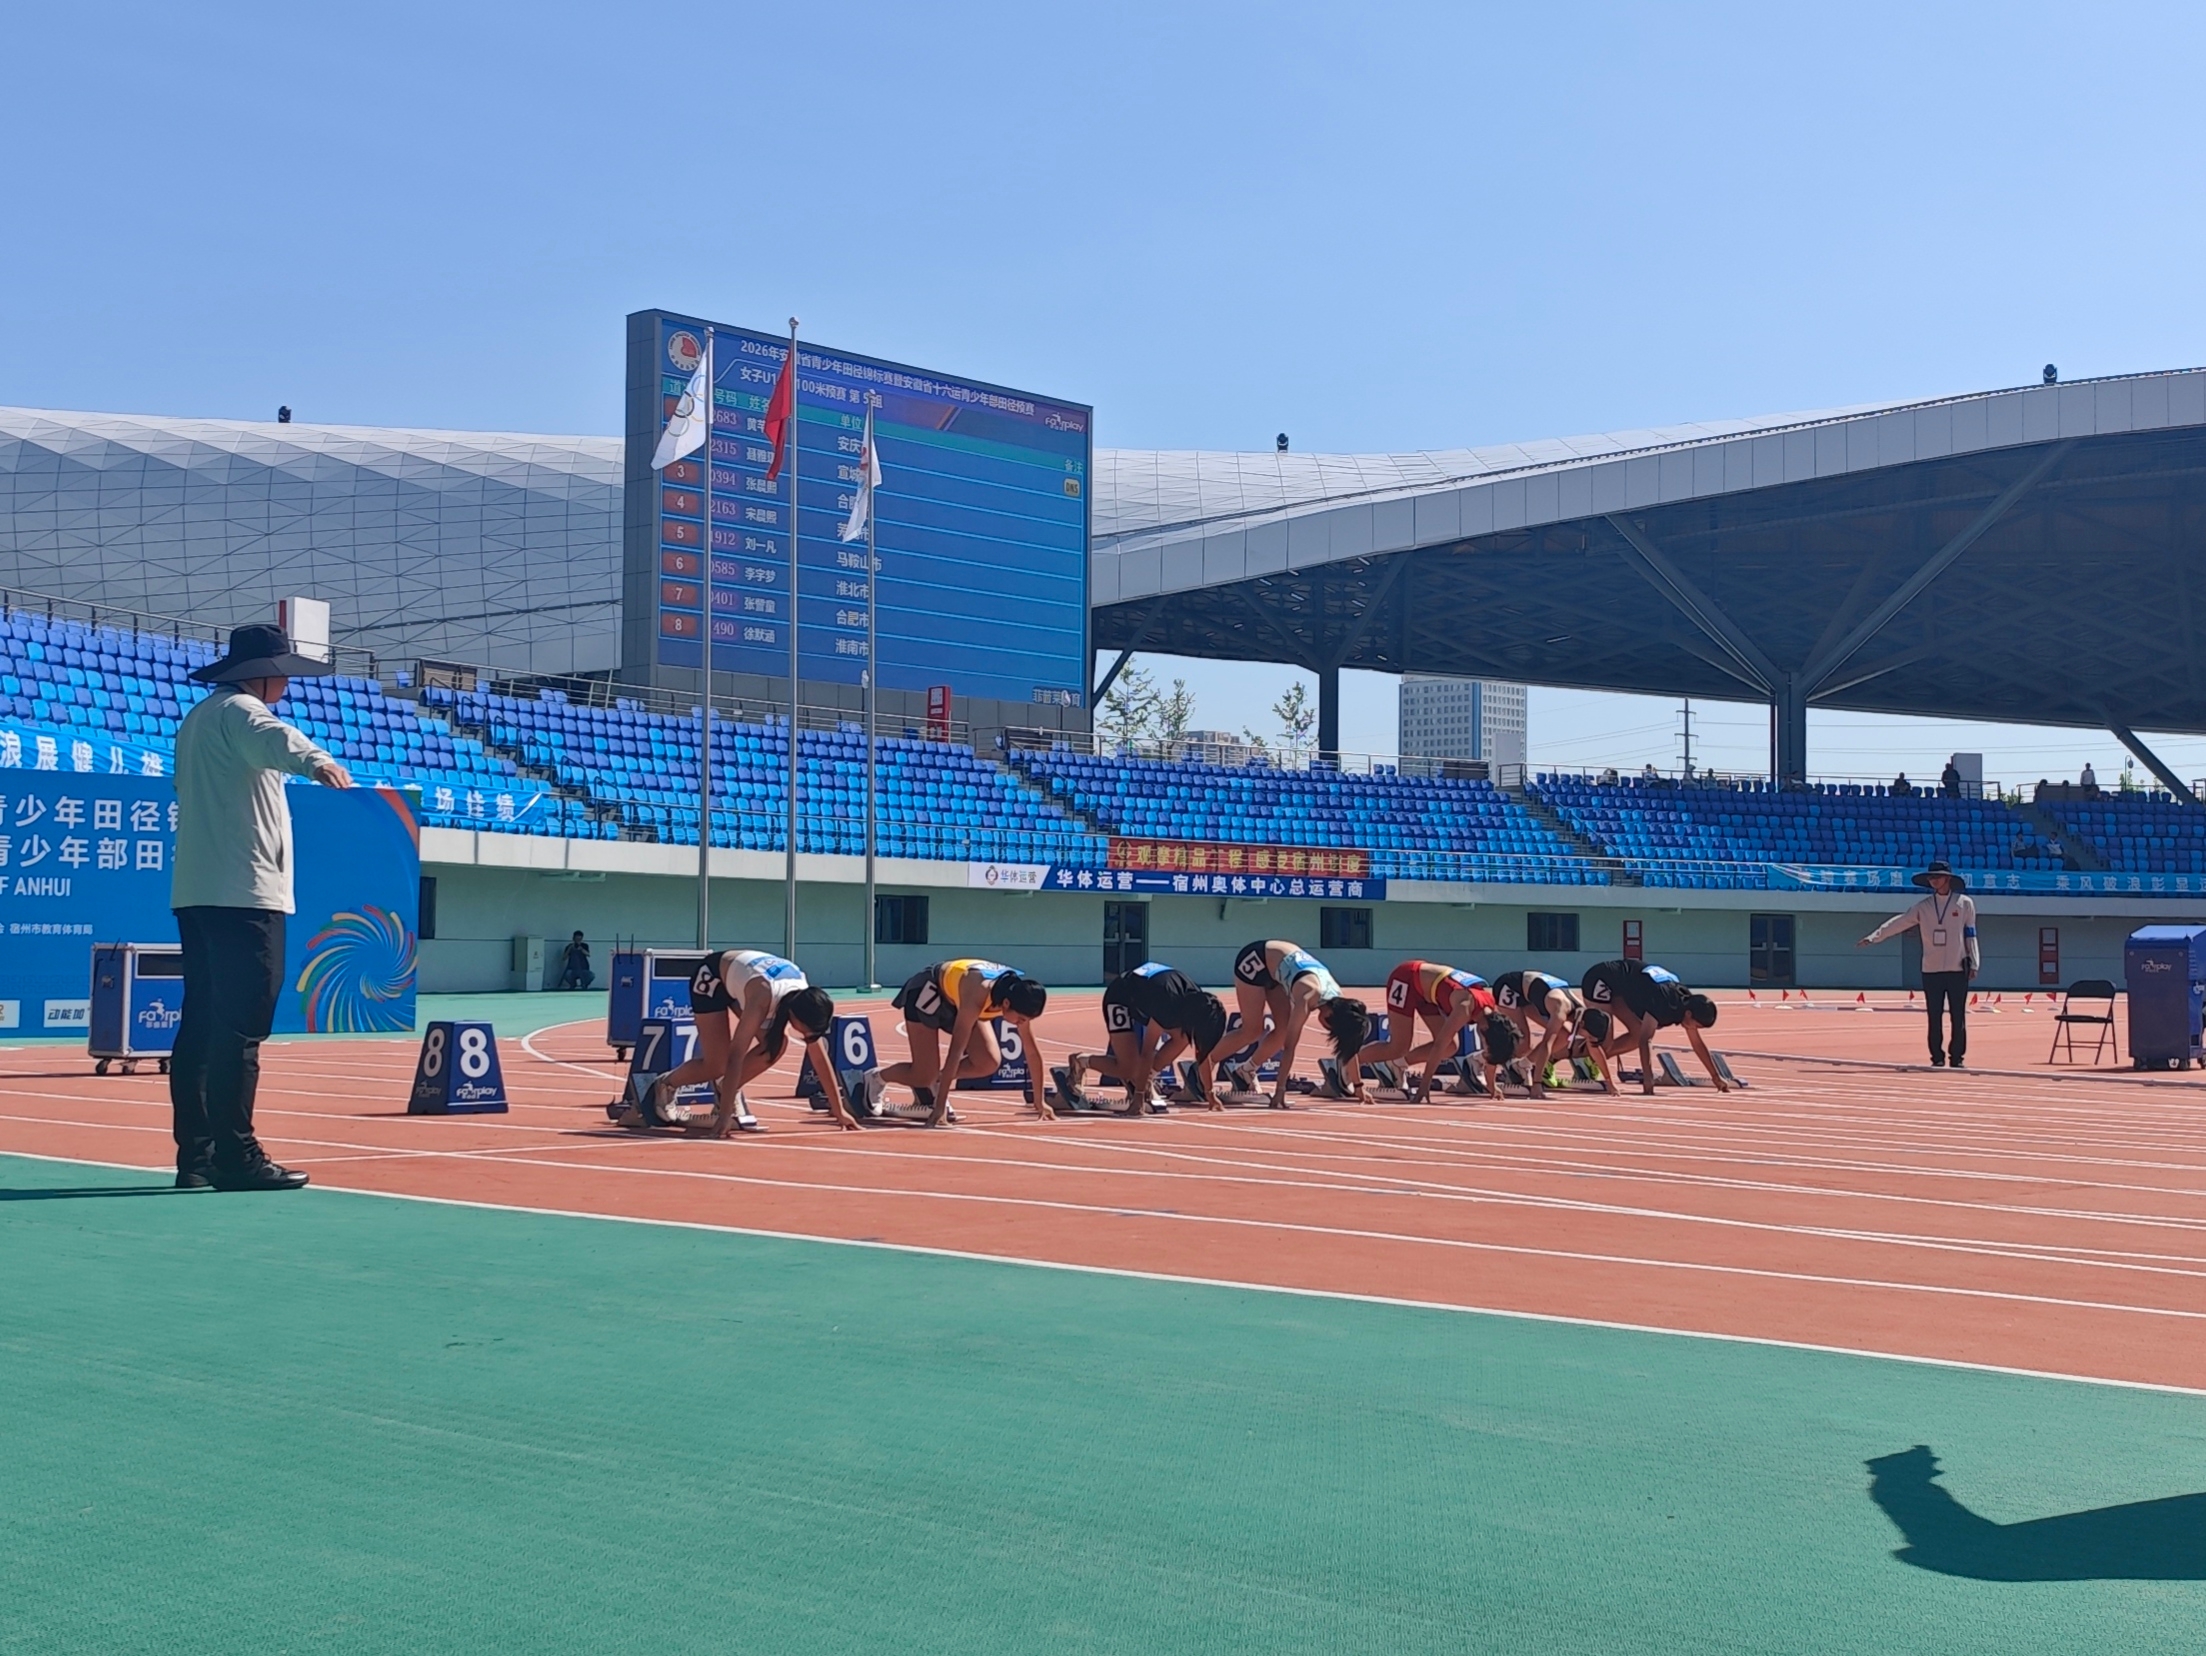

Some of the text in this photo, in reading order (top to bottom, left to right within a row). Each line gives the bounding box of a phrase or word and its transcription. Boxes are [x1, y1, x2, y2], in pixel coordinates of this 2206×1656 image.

[740, 366, 777, 386] 女子U1
[740, 339, 1035, 416] 2026年安省青少年田径锦标赛暨安徽省十六运青少年部田径预赛
[714, 388, 737, 406] 号码
[840, 414, 862, 430] 单位
[1064, 459, 1083, 474] 备注
[677, 465, 686, 477] 3
[677, 495, 685, 509] 4
[676, 526, 685, 539] 5
[745, 536, 778, 554] 刘一凡
[676, 556, 684, 570] 6
[836, 580, 869, 599] 淮北市
[675, 587, 683, 600] 7
[835, 609, 869, 628] 合肥市
[675, 618, 683, 631] 8
[835, 638, 869, 657] 淮南市
[1032, 688, 1082, 708] 菲普莱育
[0, 794, 179, 833] 少年田径
[0, 834, 175, 871] 少年部田
[14, 877, 71, 896] ANHUI
[1001, 869, 1037, 884] 华体运营
[1243, 957, 1261, 976] 5
[699, 971, 713, 993] 8
[1391, 983, 1404, 1006] 4
[921, 985, 939, 1010] 7
[1502, 989, 1515, 1006] 3
[138, 1003, 182, 1029] fairpl
[1114, 1006, 1127, 1028] 6
[423, 1028, 490, 1078] 8 8
[642, 1025, 699, 1071] 7 7
[843, 1021, 869, 1066] 6
[1000, 1020, 1022, 1060] 5
